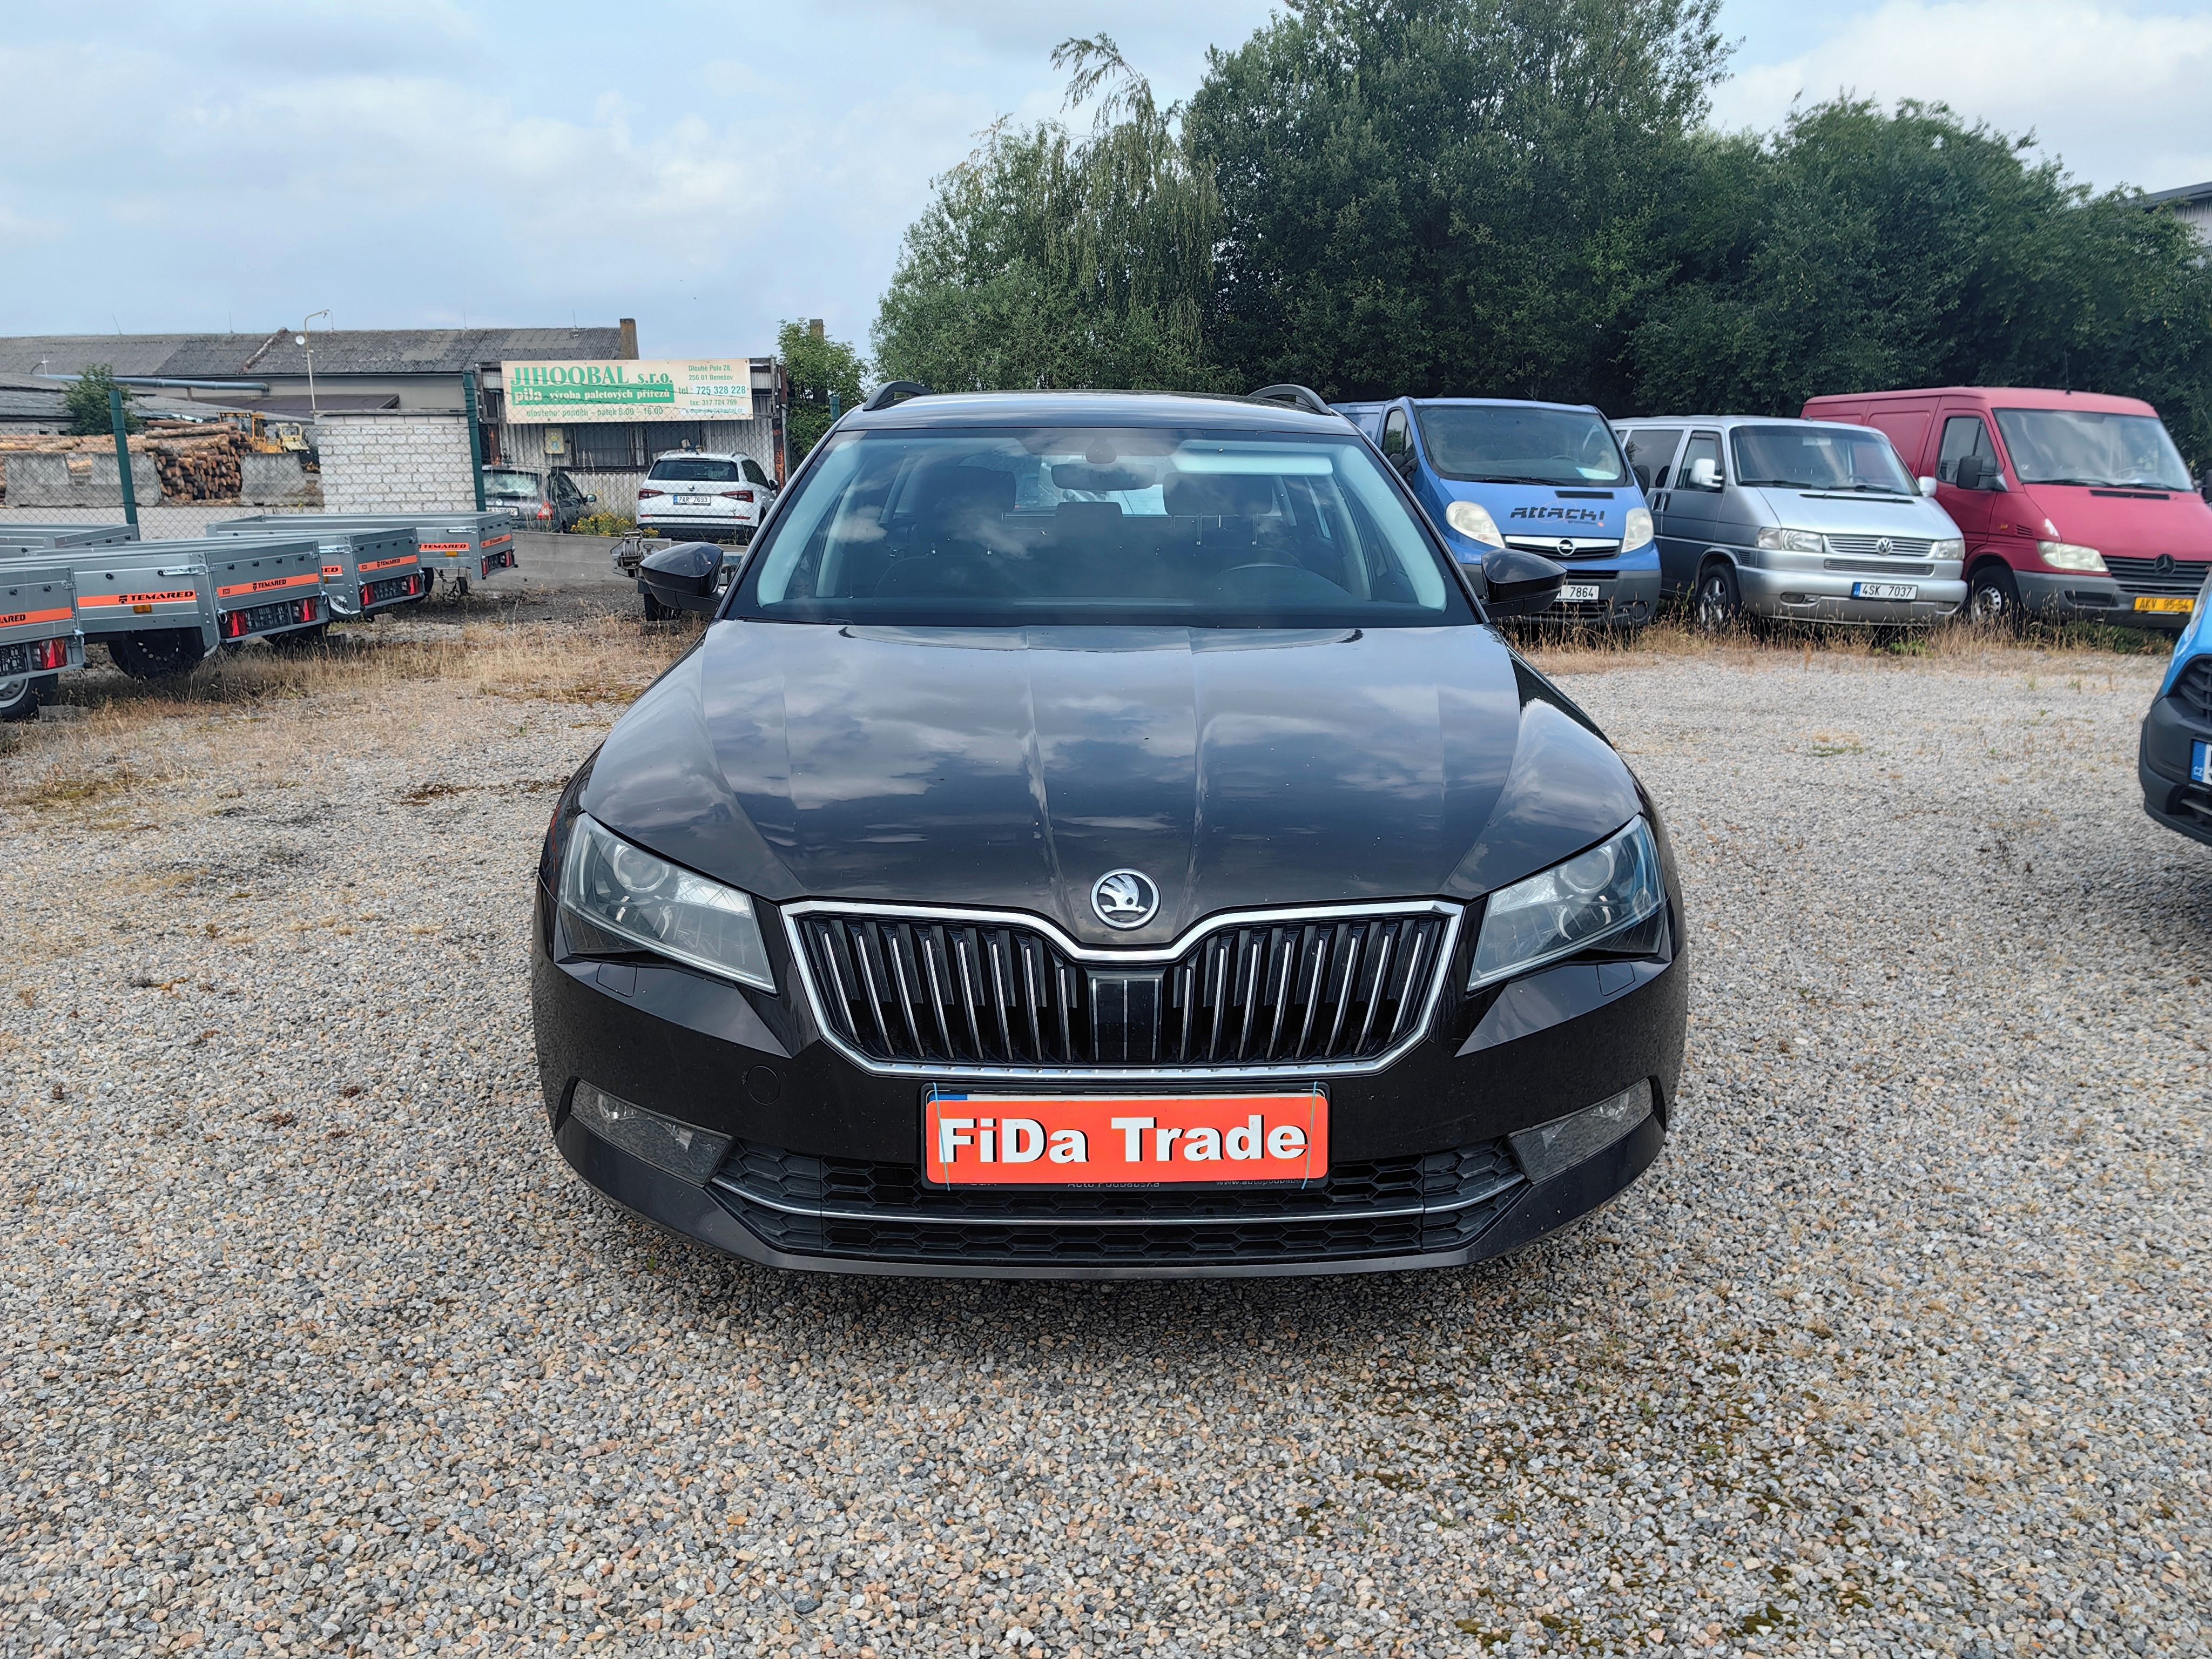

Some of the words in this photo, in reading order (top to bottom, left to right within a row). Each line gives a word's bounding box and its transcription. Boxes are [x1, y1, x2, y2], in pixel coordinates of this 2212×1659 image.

[510, 366, 629, 386] JIHOOBAL
[637, 372, 673, 384] s.r.o.
[514, 388, 543, 404] pila
[549, 390, 581, 401] výroba
[584, 389, 633, 400] paletových
[696, 386, 711, 395] 725
[713, 386, 729, 394] 328
[731, 386, 746, 394] 228
[258, 579, 287, 588] TEMARED
[131, 590, 194, 601] TEMARED
[1569, 586, 1594, 598] 7864
[1862, 584, 1881, 596] 4SK
[1887, 586, 1913, 597] 7037
[2139, 598, 2157, 610] AKV
[939, 1117, 1089, 1163] FiDa
[1111, 1114, 1309, 1163] Trade
